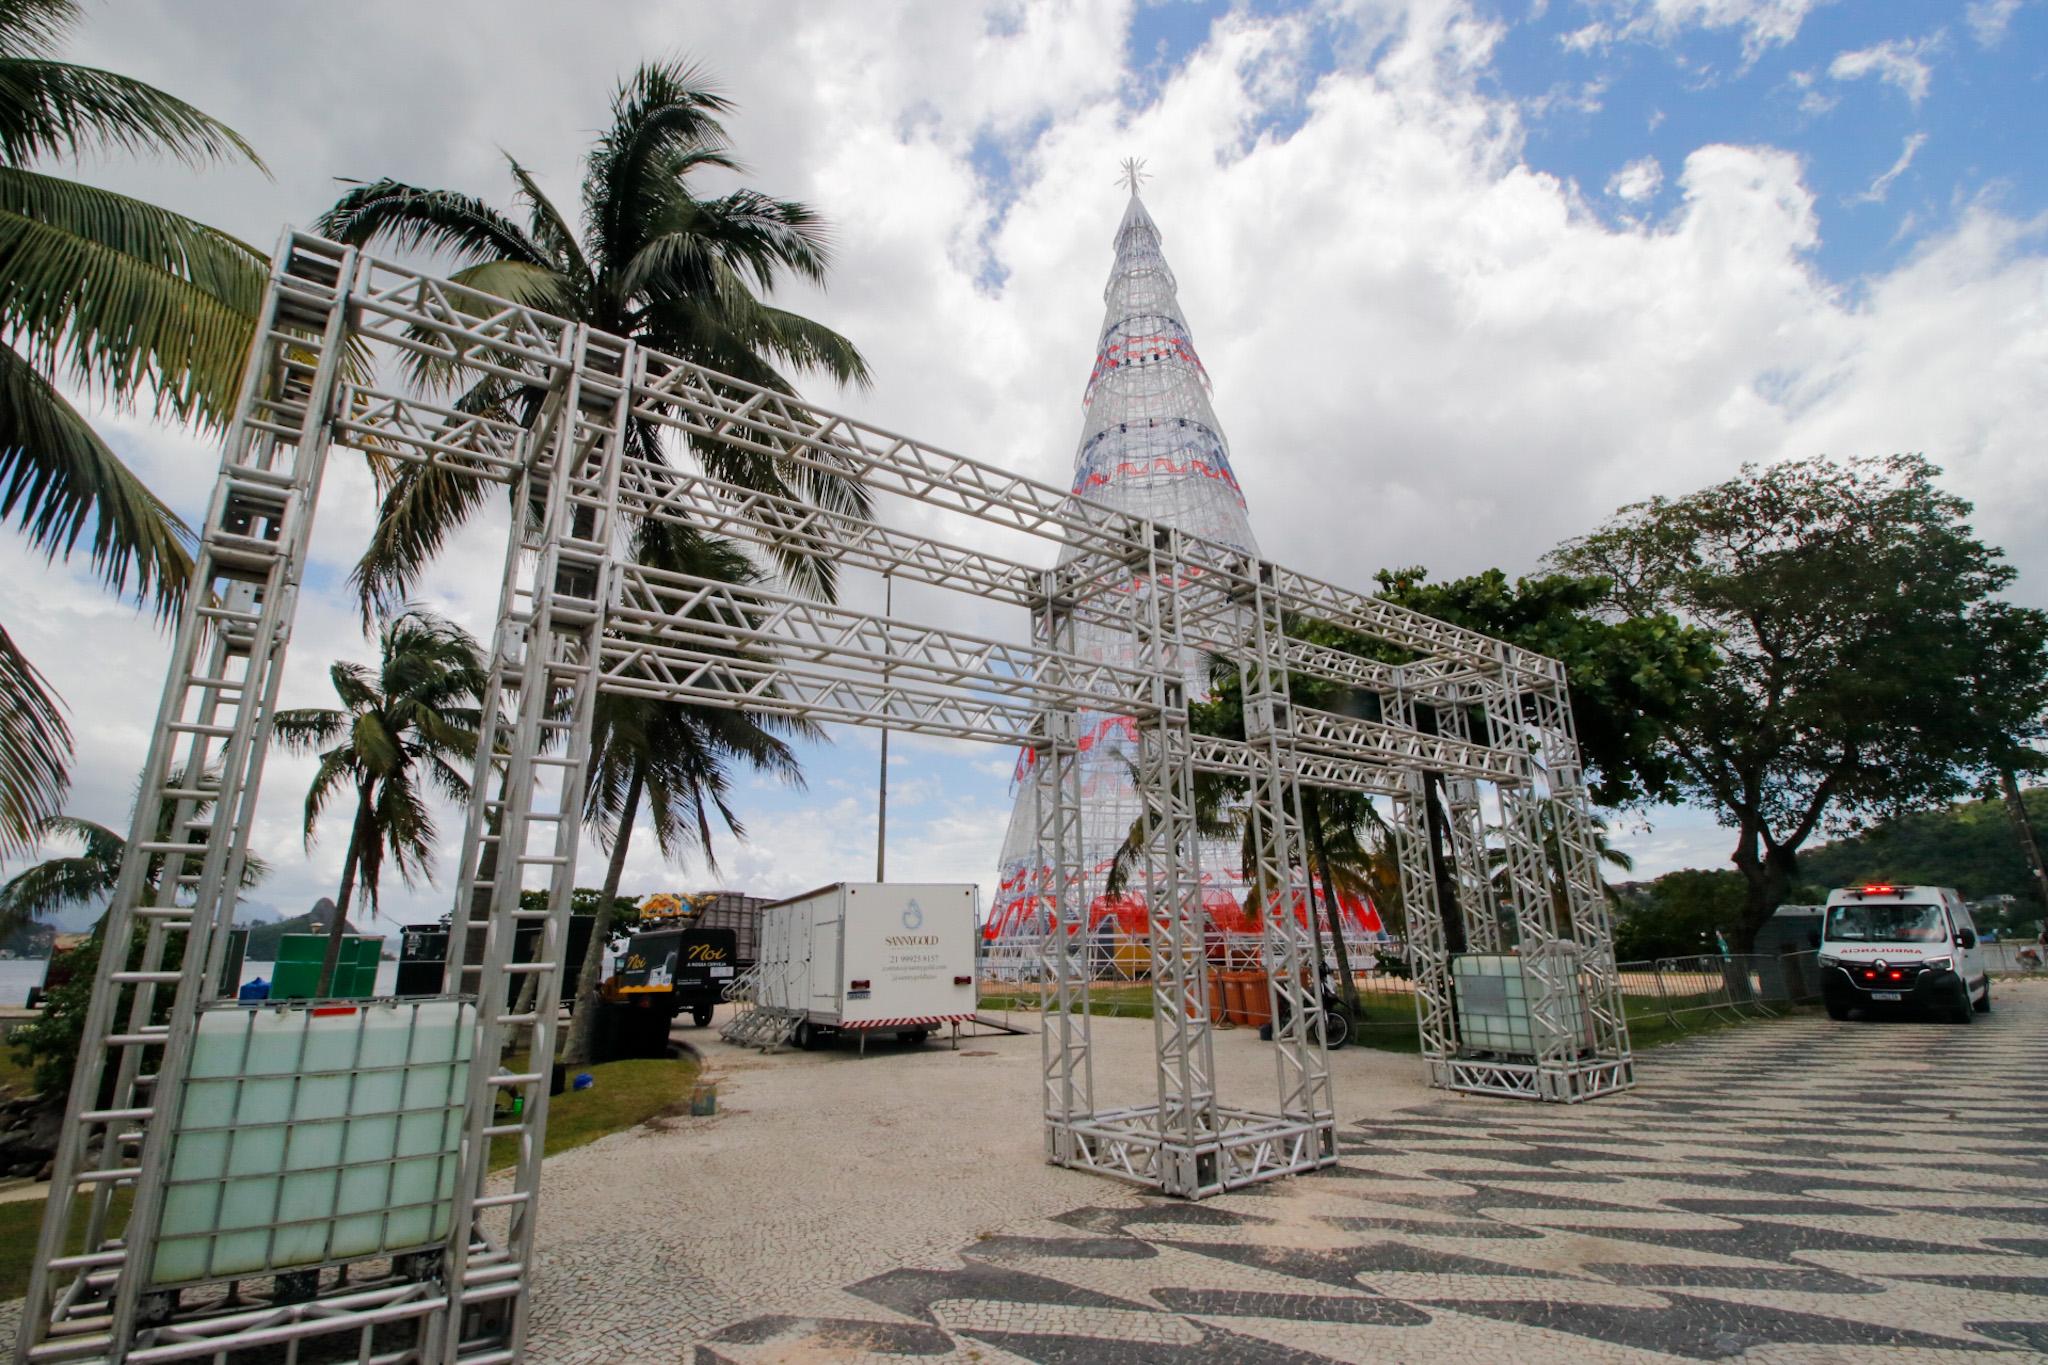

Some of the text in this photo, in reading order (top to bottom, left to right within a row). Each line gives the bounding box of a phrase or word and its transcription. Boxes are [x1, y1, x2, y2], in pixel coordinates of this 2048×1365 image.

[885, 935, 939, 946] SANNYGOLD
[688, 944, 727, 960] Noi
[627, 953, 647, 969] Noi
